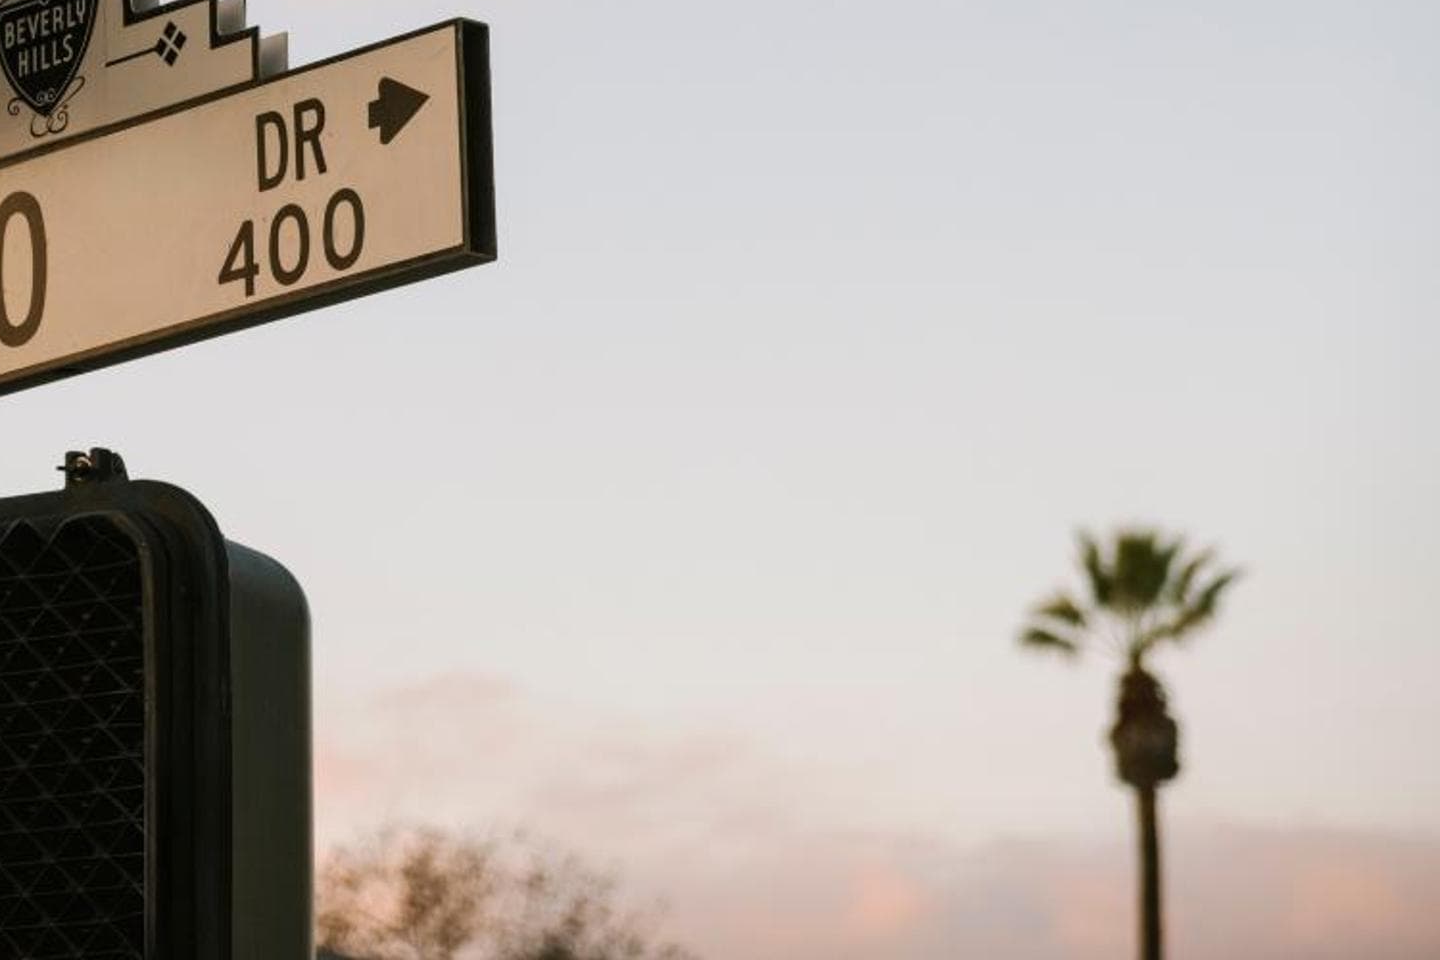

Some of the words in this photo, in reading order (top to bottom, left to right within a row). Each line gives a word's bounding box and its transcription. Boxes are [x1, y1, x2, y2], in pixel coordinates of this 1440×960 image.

[18, 34, 74, 78] HILLS
[254, 97, 327, 193] DR
[217, 187, 366, 298] 400
